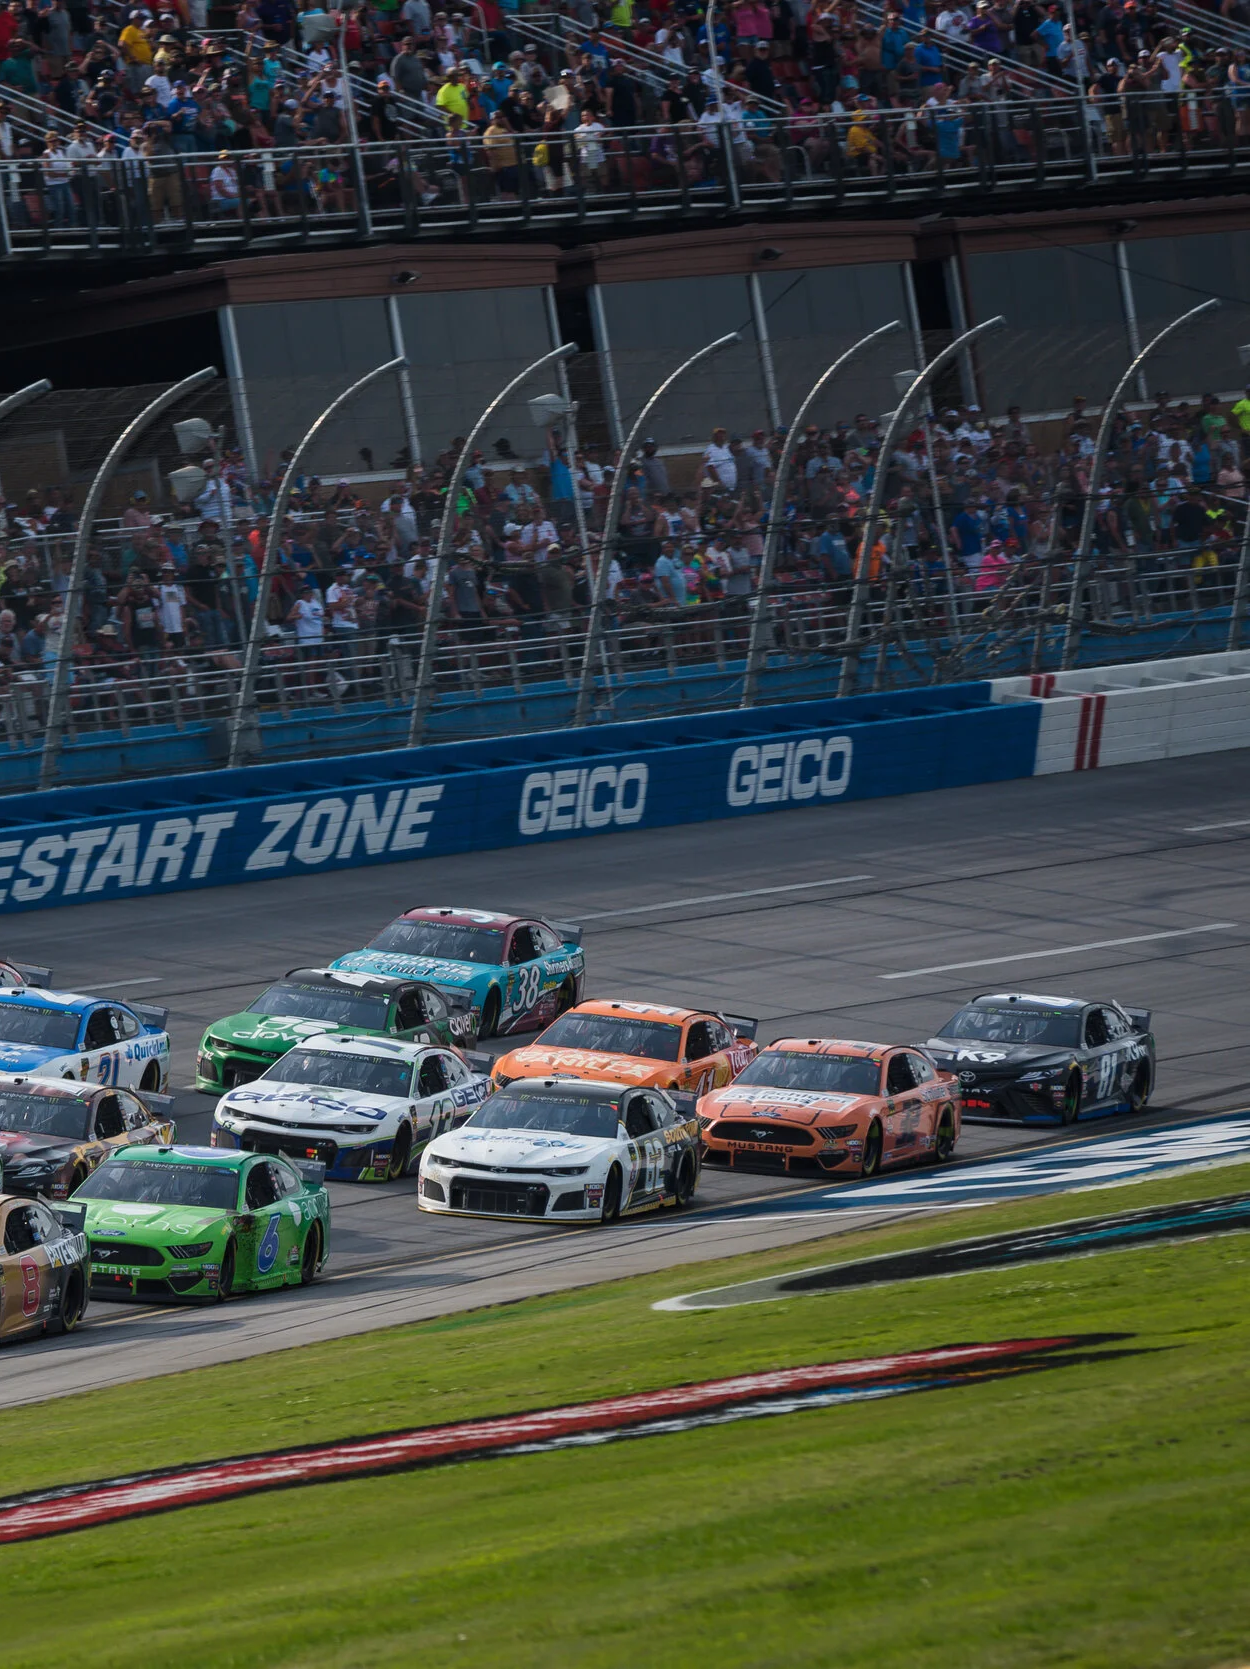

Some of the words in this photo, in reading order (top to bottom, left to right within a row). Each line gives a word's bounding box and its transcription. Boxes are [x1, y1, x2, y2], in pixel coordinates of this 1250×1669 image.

[726, 736, 853, 806] GEICO
[519, 763, 647, 836] GEICO
[245, 784, 443, 870] ZONE
[512, 965, 540, 1012] 38
[232, 1028, 299, 1042] clov
[228, 1091, 388, 1120] GEICO
[451, 1079, 492, 1108] GEICO
[727, 1141, 794, 1152] MUSTANG
[100, 1215, 193, 1235] orns
[258, 1212, 282, 1274] 6
[19, 1254, 41, 1318] 8
[91, 1264, 141, 1276] STANG
